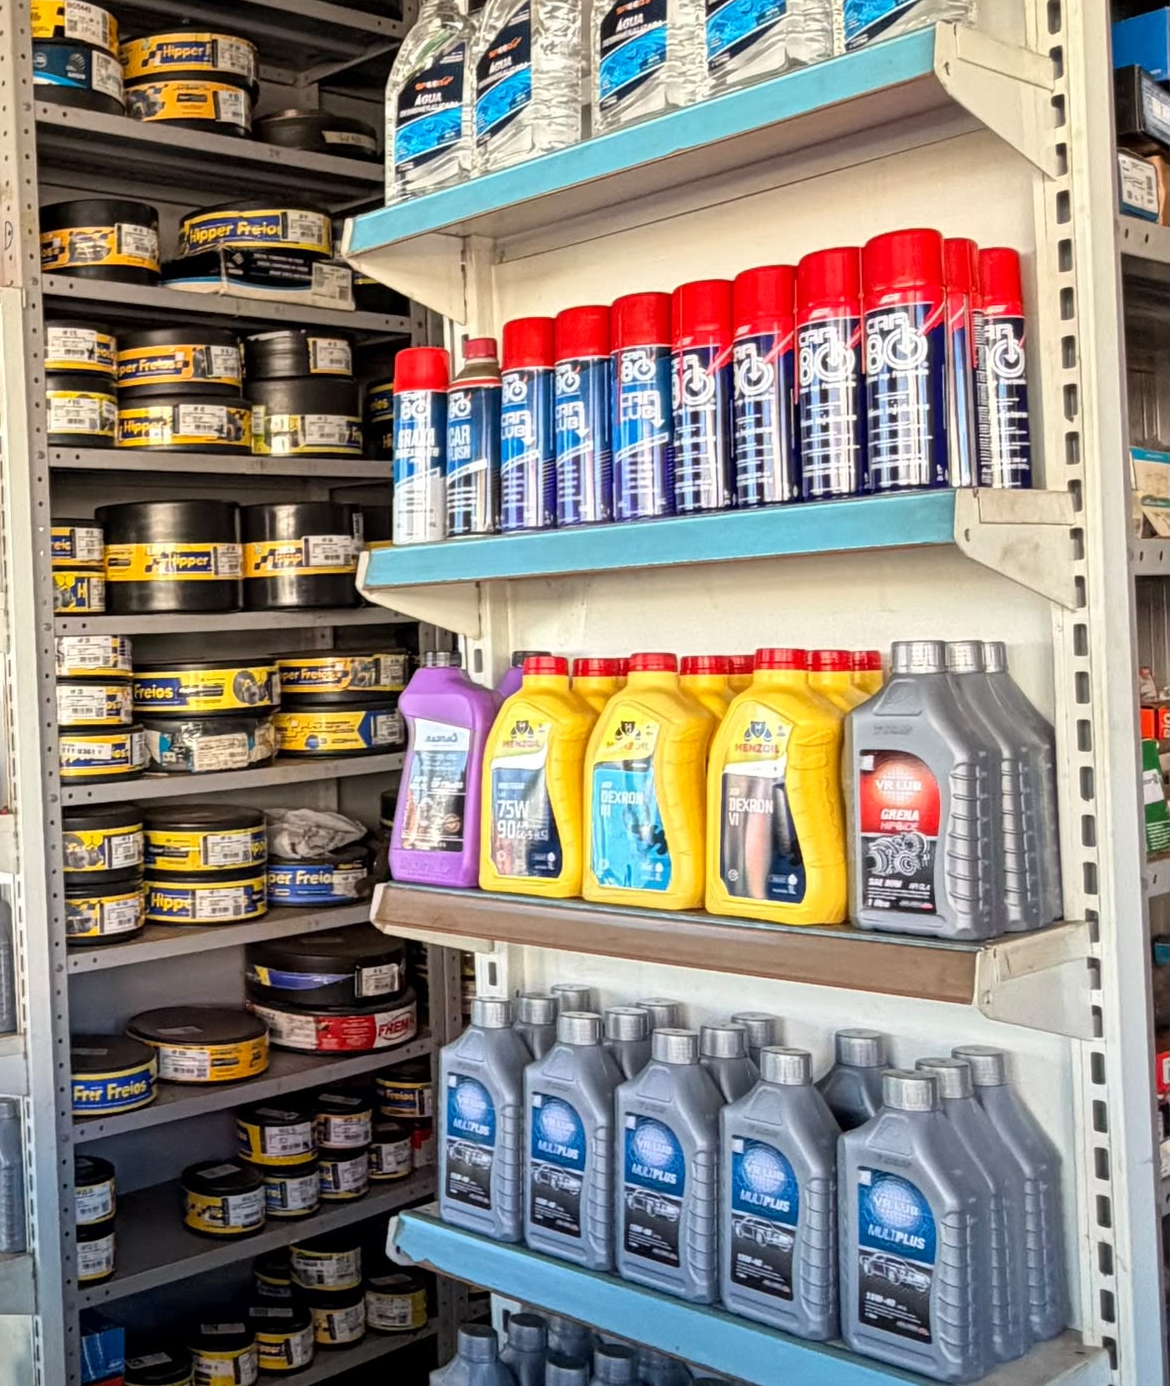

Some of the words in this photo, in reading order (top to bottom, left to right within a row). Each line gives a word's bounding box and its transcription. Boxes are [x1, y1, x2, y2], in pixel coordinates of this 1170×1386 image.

[162, 42, 207, 59] Hipper
[189, 222, 234, 243] Hipper
[133, 682, 174, 701] Freios
[896, 780, 922, 791] LUB
[601, 790, 644, 805] DEXRON
[729, 797, 774, 814] DEXRON
[497, 799, 530, 819] 75W
[728, 813, 740, 826] VI
[497, 820, 517, 839] 90
[151, 892, 192, 910] Hipp
[107, 1080, 148, 1099] Freios
[631, 1163, 678, 1185] MULTIPLUS
[739, 1189, 790, 1213] MULTIPLUS
[867, 1223, 927, 1250] MULTIPLUS
